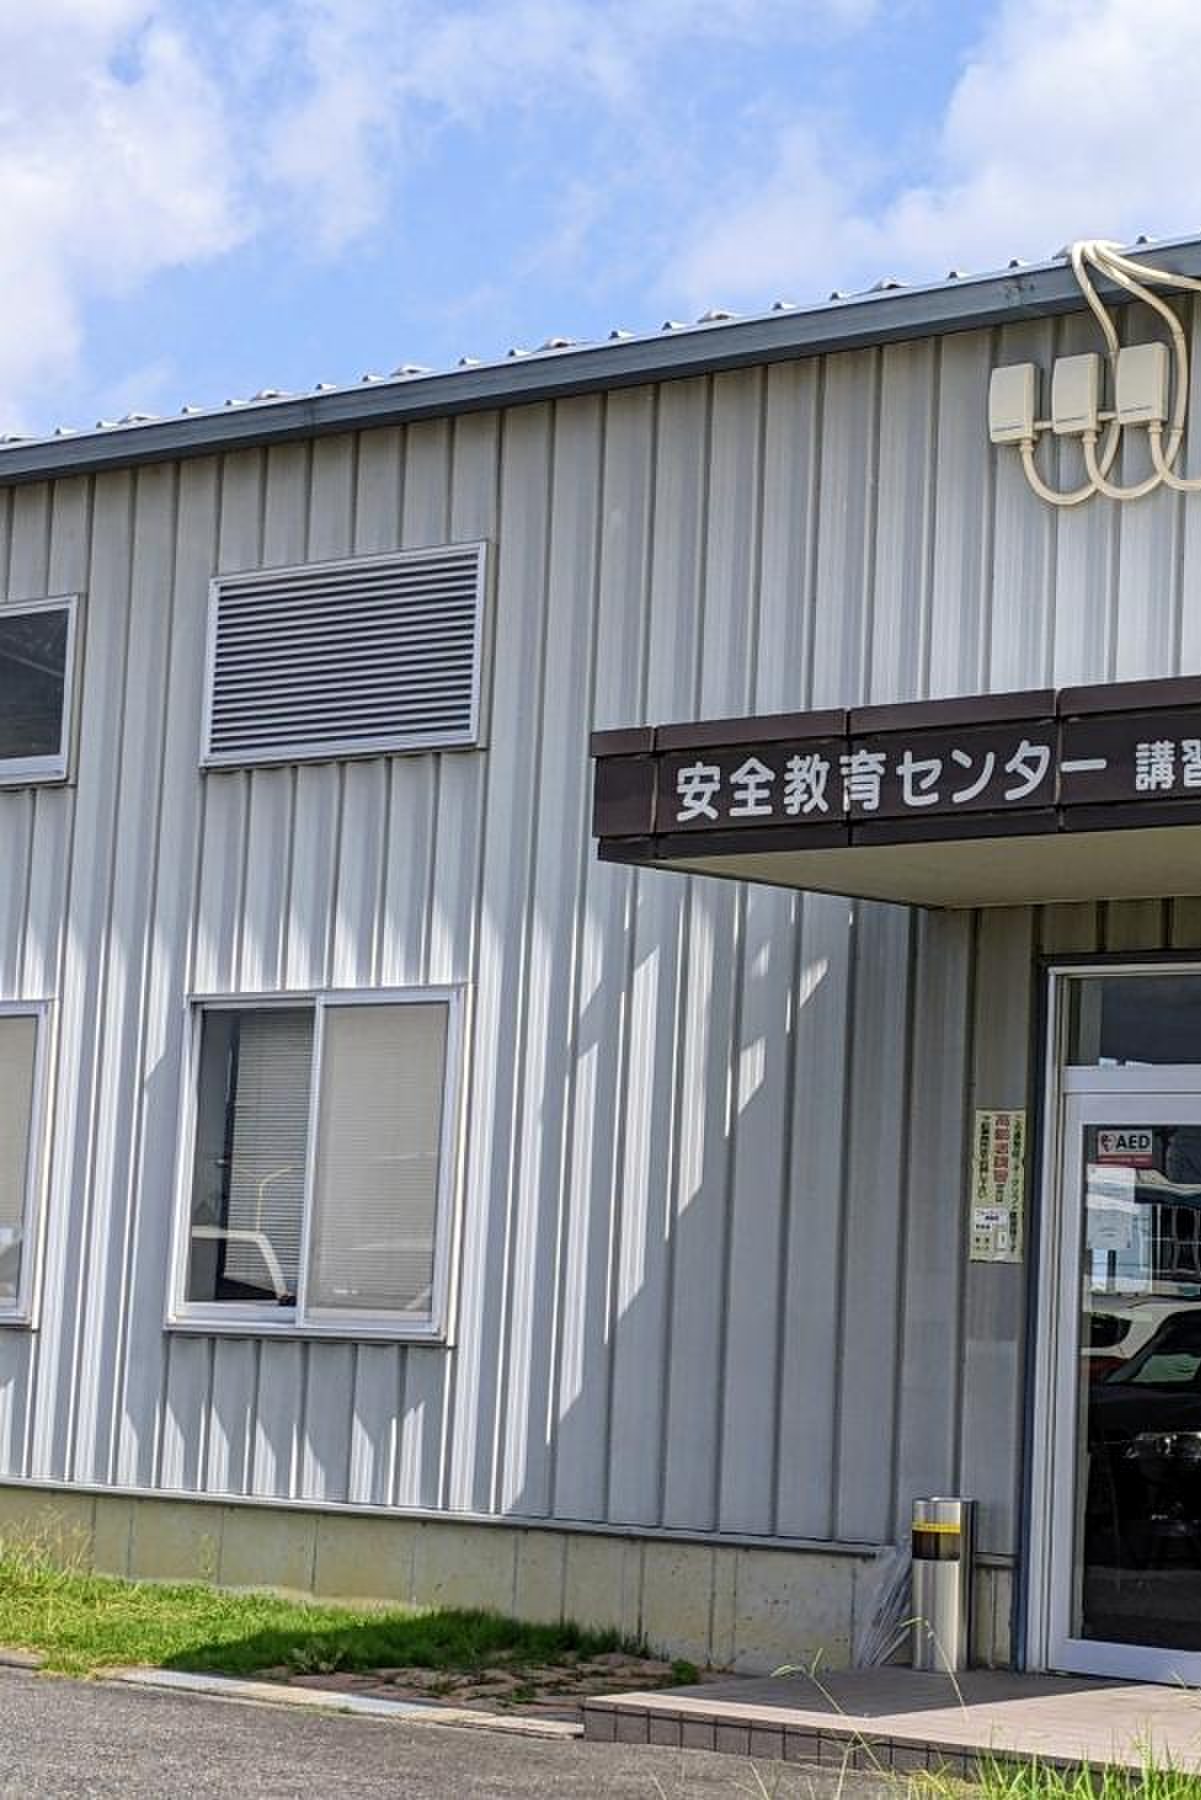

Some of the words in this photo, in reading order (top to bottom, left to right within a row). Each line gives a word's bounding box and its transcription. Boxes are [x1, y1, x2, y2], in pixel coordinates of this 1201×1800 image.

[676, 739, 1107, 822] 安全教育センター
[1116, 1135, 1150, 1149] AED
